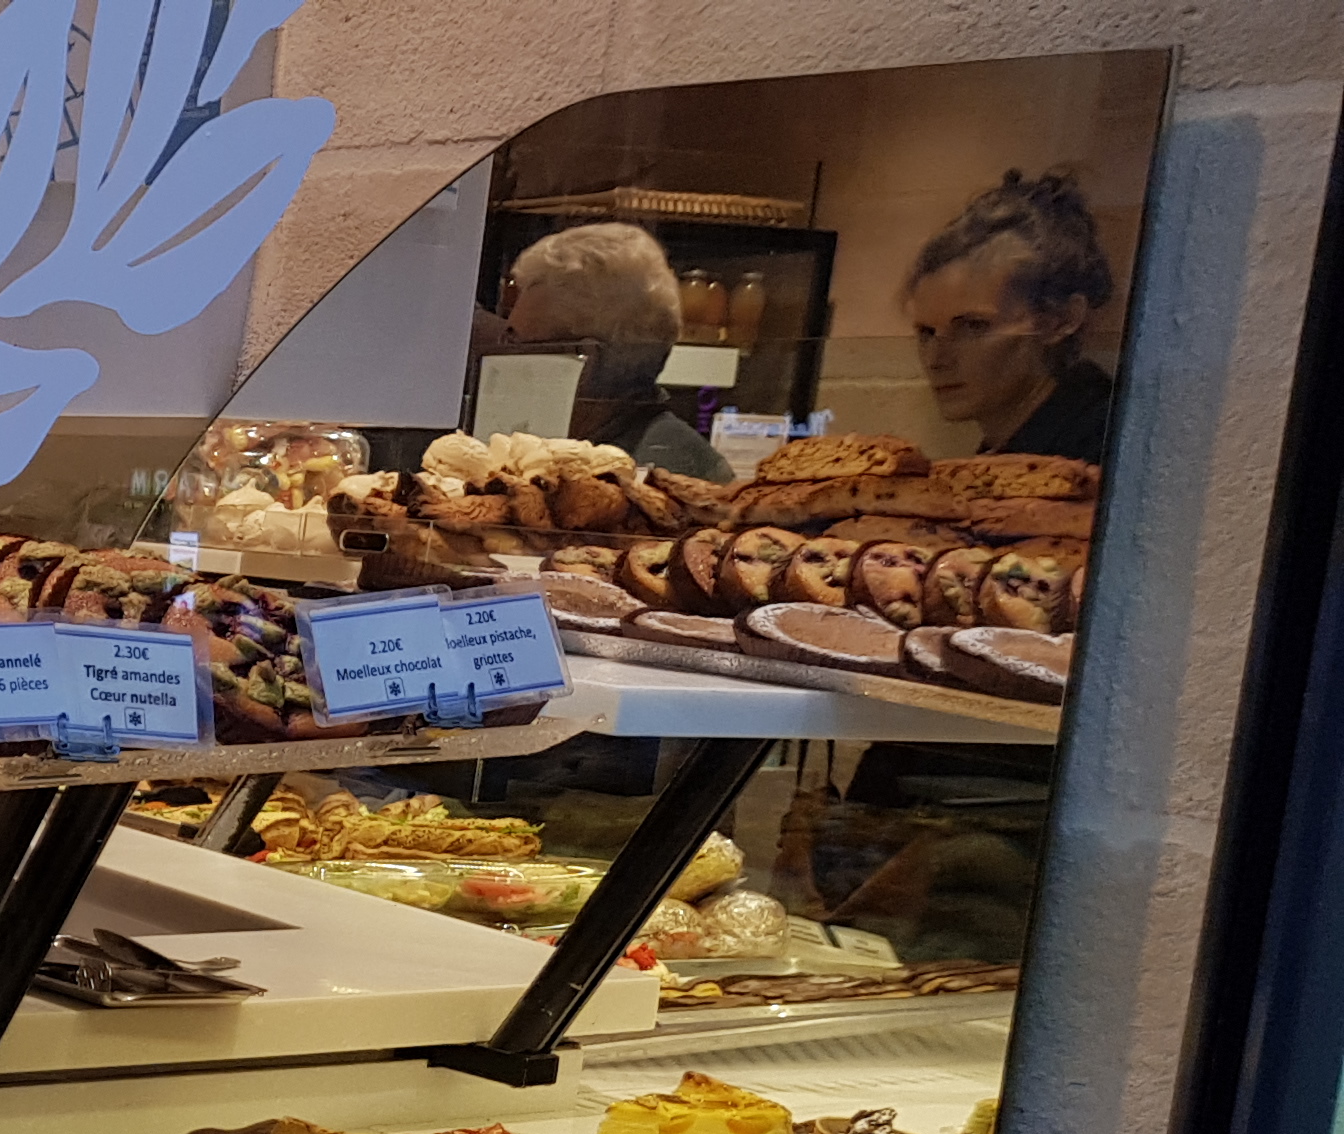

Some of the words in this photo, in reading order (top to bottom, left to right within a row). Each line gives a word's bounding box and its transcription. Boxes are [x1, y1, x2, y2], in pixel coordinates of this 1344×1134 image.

[466, 609, 497, 625] 2.20€
[490, 626, 537, 645] pistache,
[113, 645, 150, 660] 2.30€
[369, 638, 404, 655] 2.20€
[336, 660, 392, 682] Moelleux
[394, 655, 443, 673] chocolat
[473, 651, 514, 669] griottes
[83, 664, 118, 681] Tigré
[121, 670, 180, 685] amandes
[10, 677, 49, 694] pièces
[90, 687, 127, 702] Cœur
[131, 691, 177, 707] nutella
